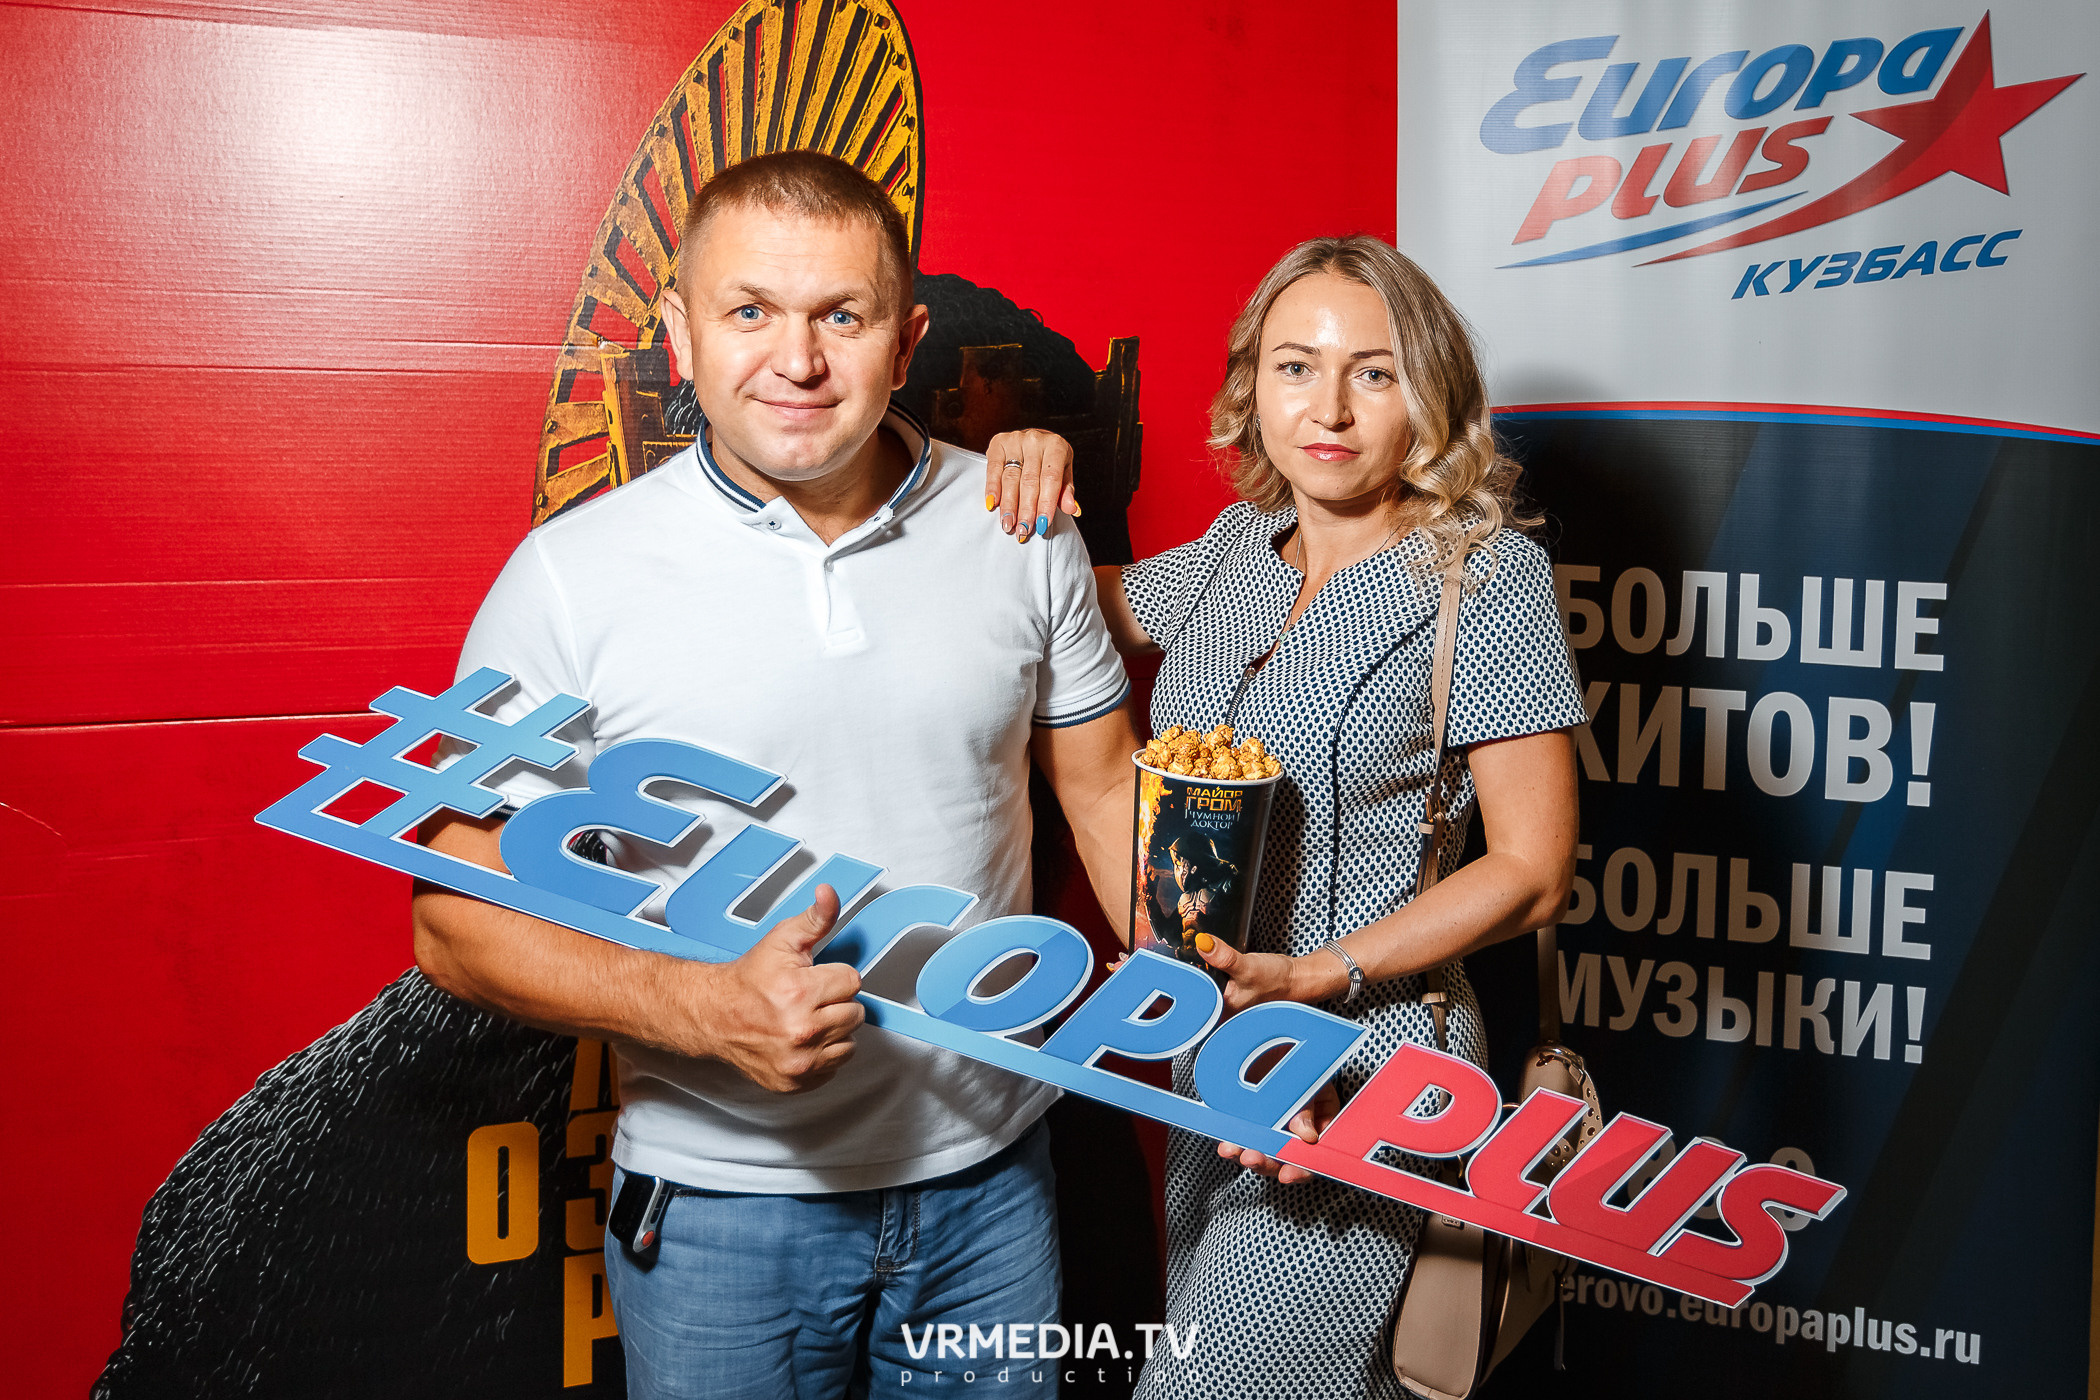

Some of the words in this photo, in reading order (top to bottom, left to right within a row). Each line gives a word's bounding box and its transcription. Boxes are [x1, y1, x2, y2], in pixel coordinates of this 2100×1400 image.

[1479, 26, 1965, 155] Europa
[1730, 228, 2024, 300] КУЗБАСС
[1553, 563, 1948, 672] БОЛЬШЕ
[1184, 795, 1243, 812] ГРОМ
[1186, 785, 1244, 799] МАЙОР
[1557, 949, 1927, 1064] МУЗЫКИ!
[1560, 1274, 1982, 1366] erovo.europaplus.ru
